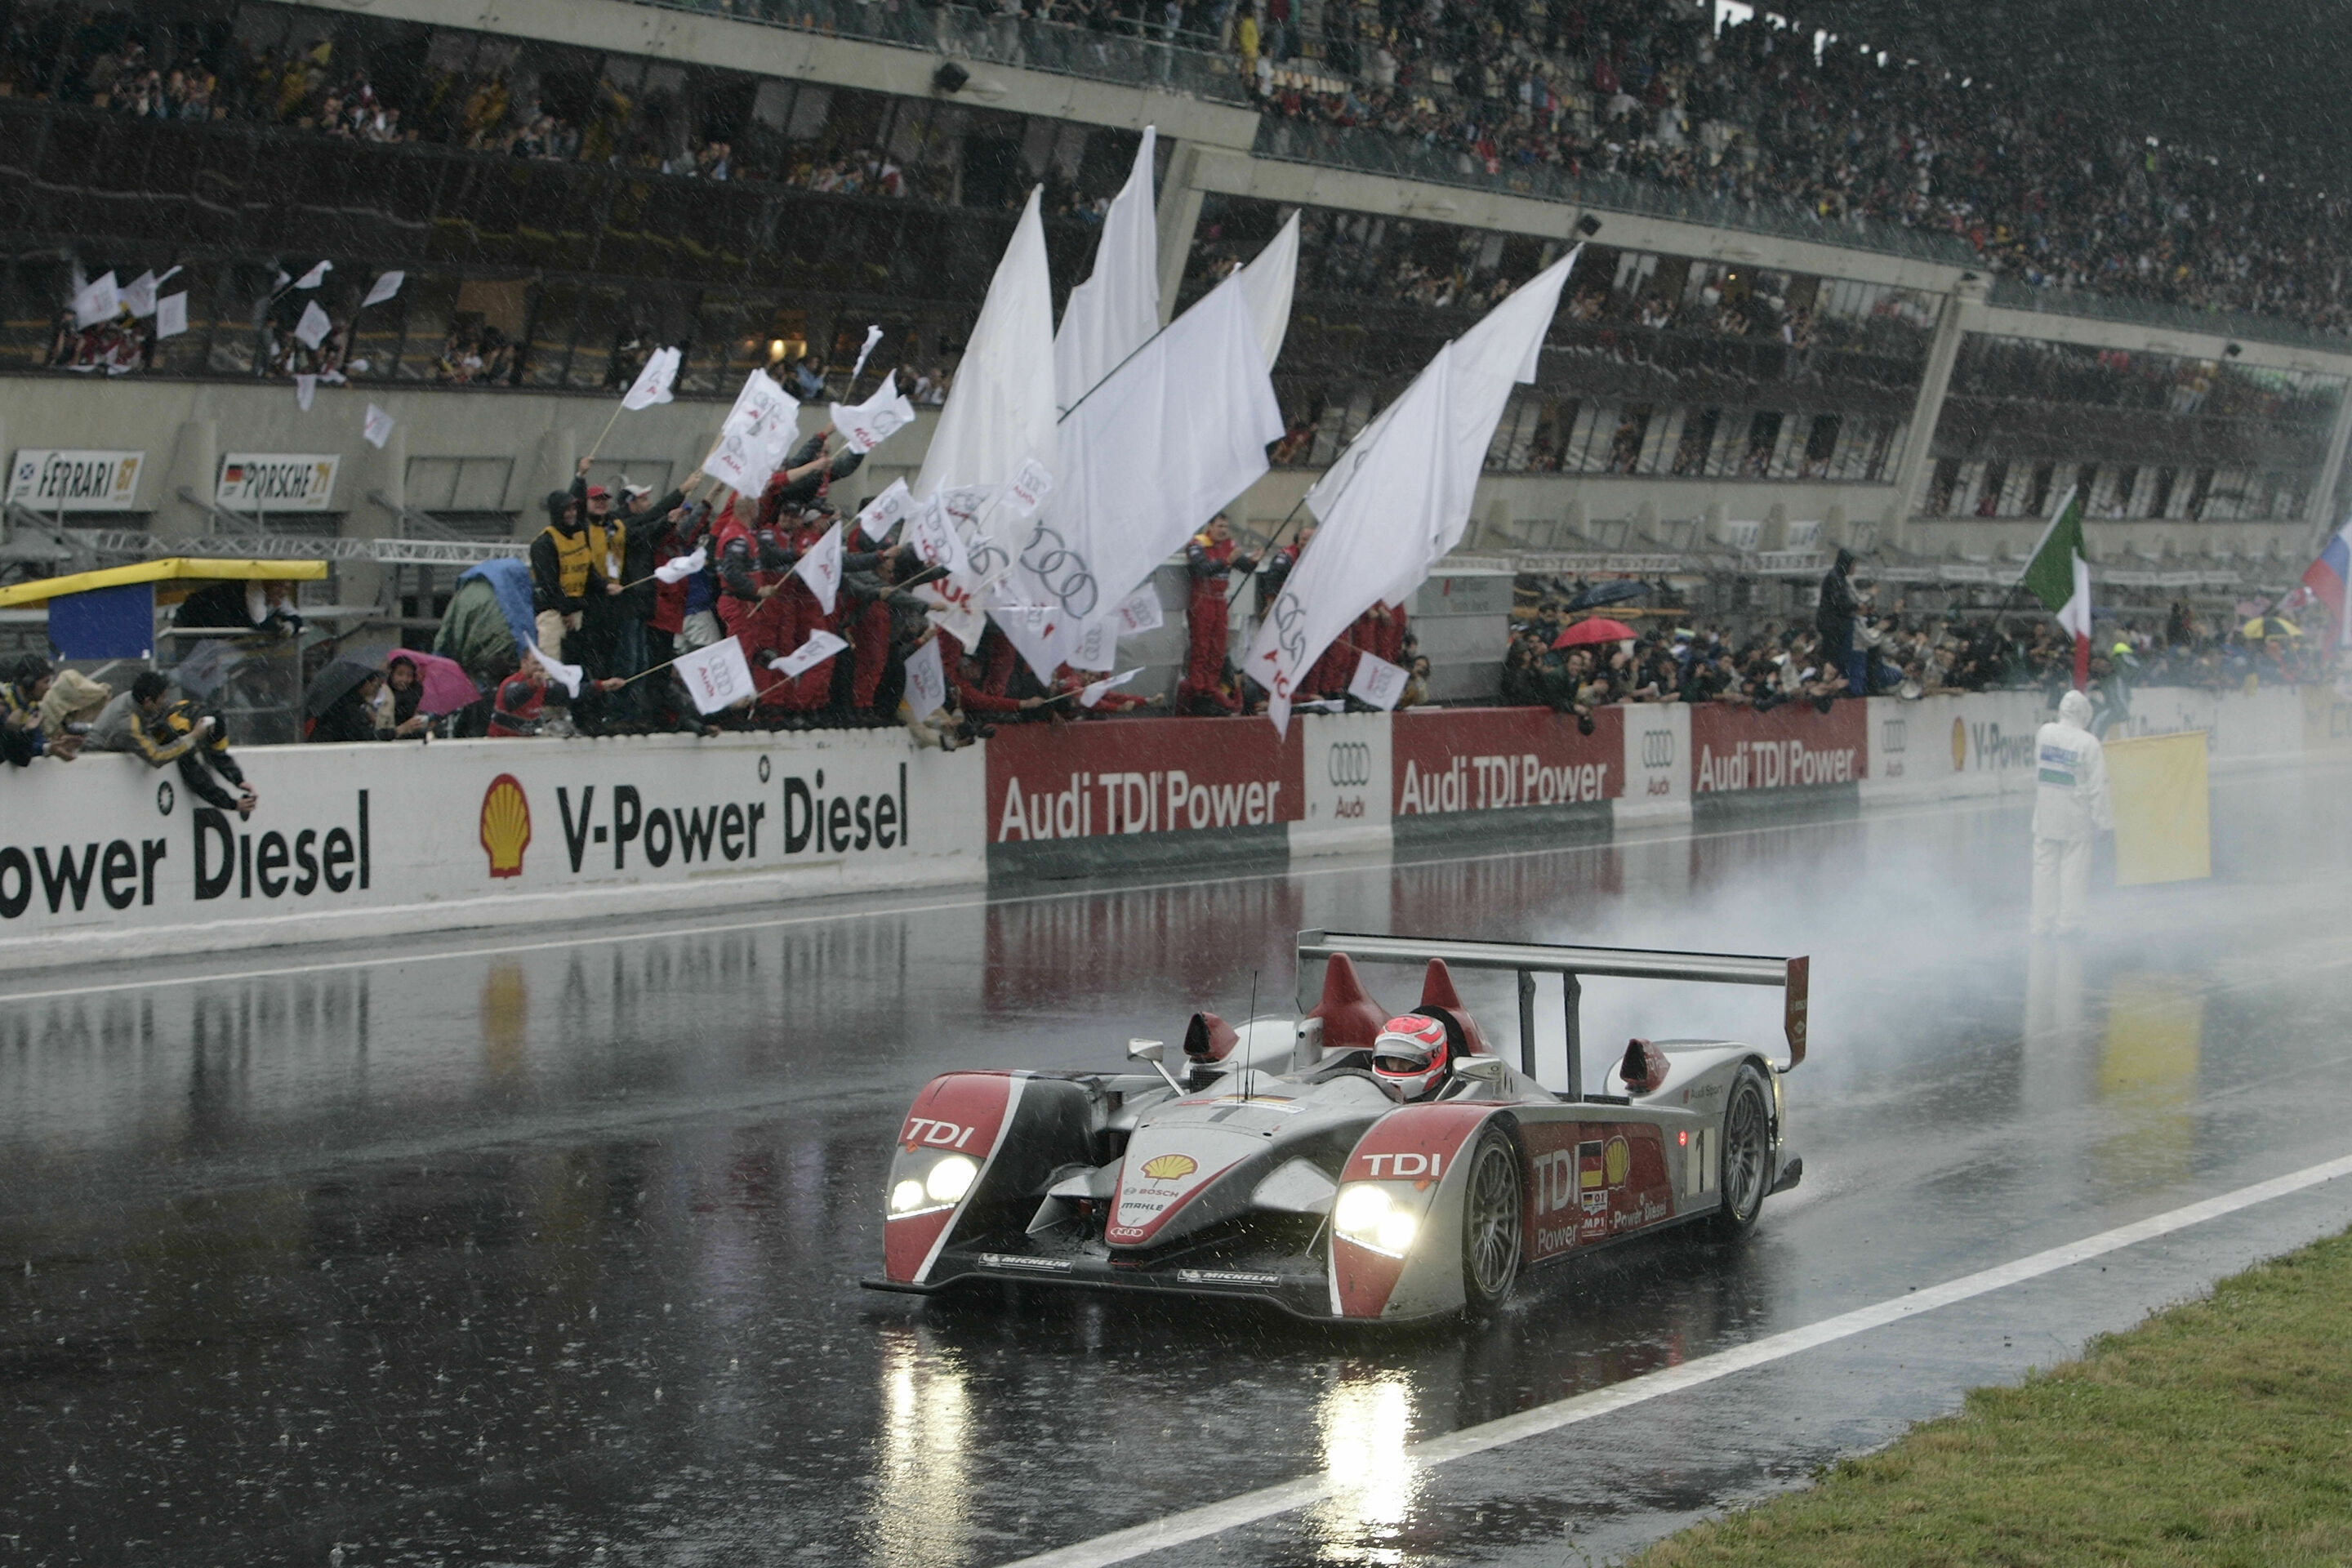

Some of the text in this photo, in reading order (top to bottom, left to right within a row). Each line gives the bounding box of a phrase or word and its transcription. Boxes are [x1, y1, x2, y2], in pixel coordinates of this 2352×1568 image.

[38, 461, 114, 497] FERRARI
[243, 461, 312, 498] PORSCHE
[1696, 739, 1855, 791] Audi TDI Power
[1399, 754, 1607, 816] Audi TDI Power
[556, 762, 907, 873] V-Power Diesel
[998, 770, 1281, 843] Audi TDI Power
[1334, 795, 1365, 819] Audi
[193, 788, 370, 901] Diesel
[1690, 1085, 1724, 1099] Audi Sport
[906, 1117, 975, 1148] TDI
[1362, 1153, 1441, 1176] TDI
[1695, 1129, 1704, 1192] 1
[1138, 1188, 1179, 1198] BOSCH
[1532, 1145, 1580, 1216] TDI
[1121, 1202, 1164, 1211] MAHLE
[1608, 1197, 1667, 1229] -Power Diesel
[1538, 1225, 1578, 1254] Power
[1001, 1256, 1072, 1268] MICHELIN
[1202, 1272, 1279, 1282] MICHELIN
